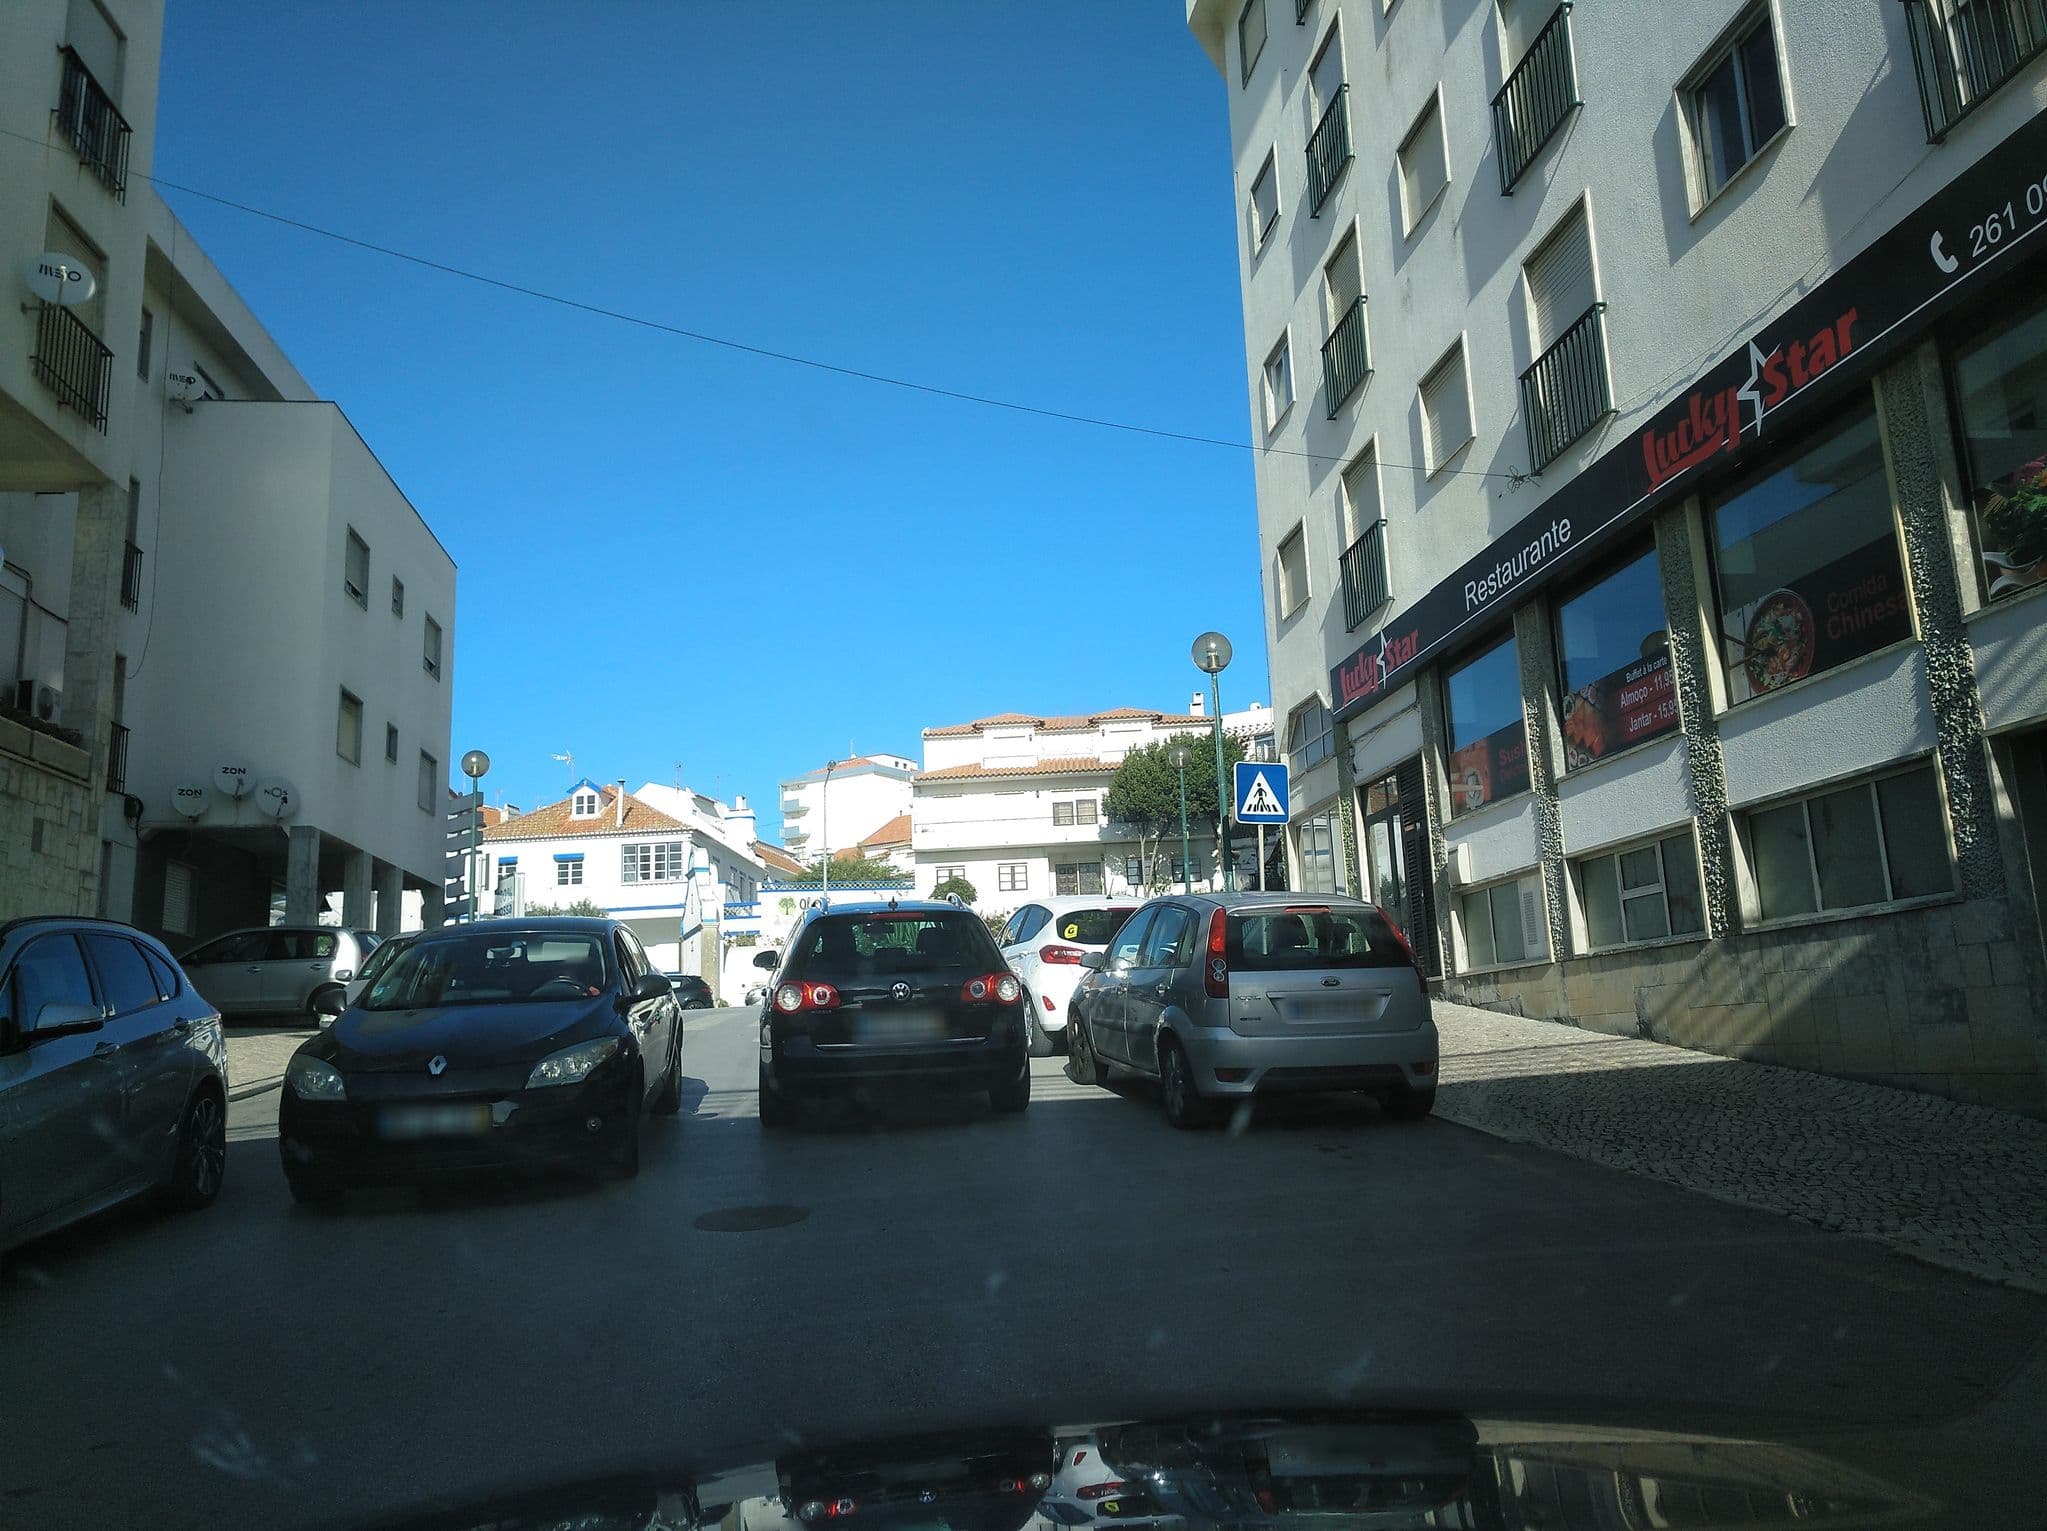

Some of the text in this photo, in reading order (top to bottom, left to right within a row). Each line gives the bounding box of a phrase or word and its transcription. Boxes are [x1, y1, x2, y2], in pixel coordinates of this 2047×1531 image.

[1969, 201, 2016, 258] 261
[1643, 307, 1857, 494] Lucky Star
[1464, 518, 1571, 611] Restaurante
[1340, 629, 1419, 707] Lucky Star
[1653, 656, 1668, 670] carte
[1620, 686, 1648, 708] Almoço
[1629, 712, 1652, 733] Jantar
[222, 767, 246, 775] ZON
[177, 788, 202, 796] ZON
